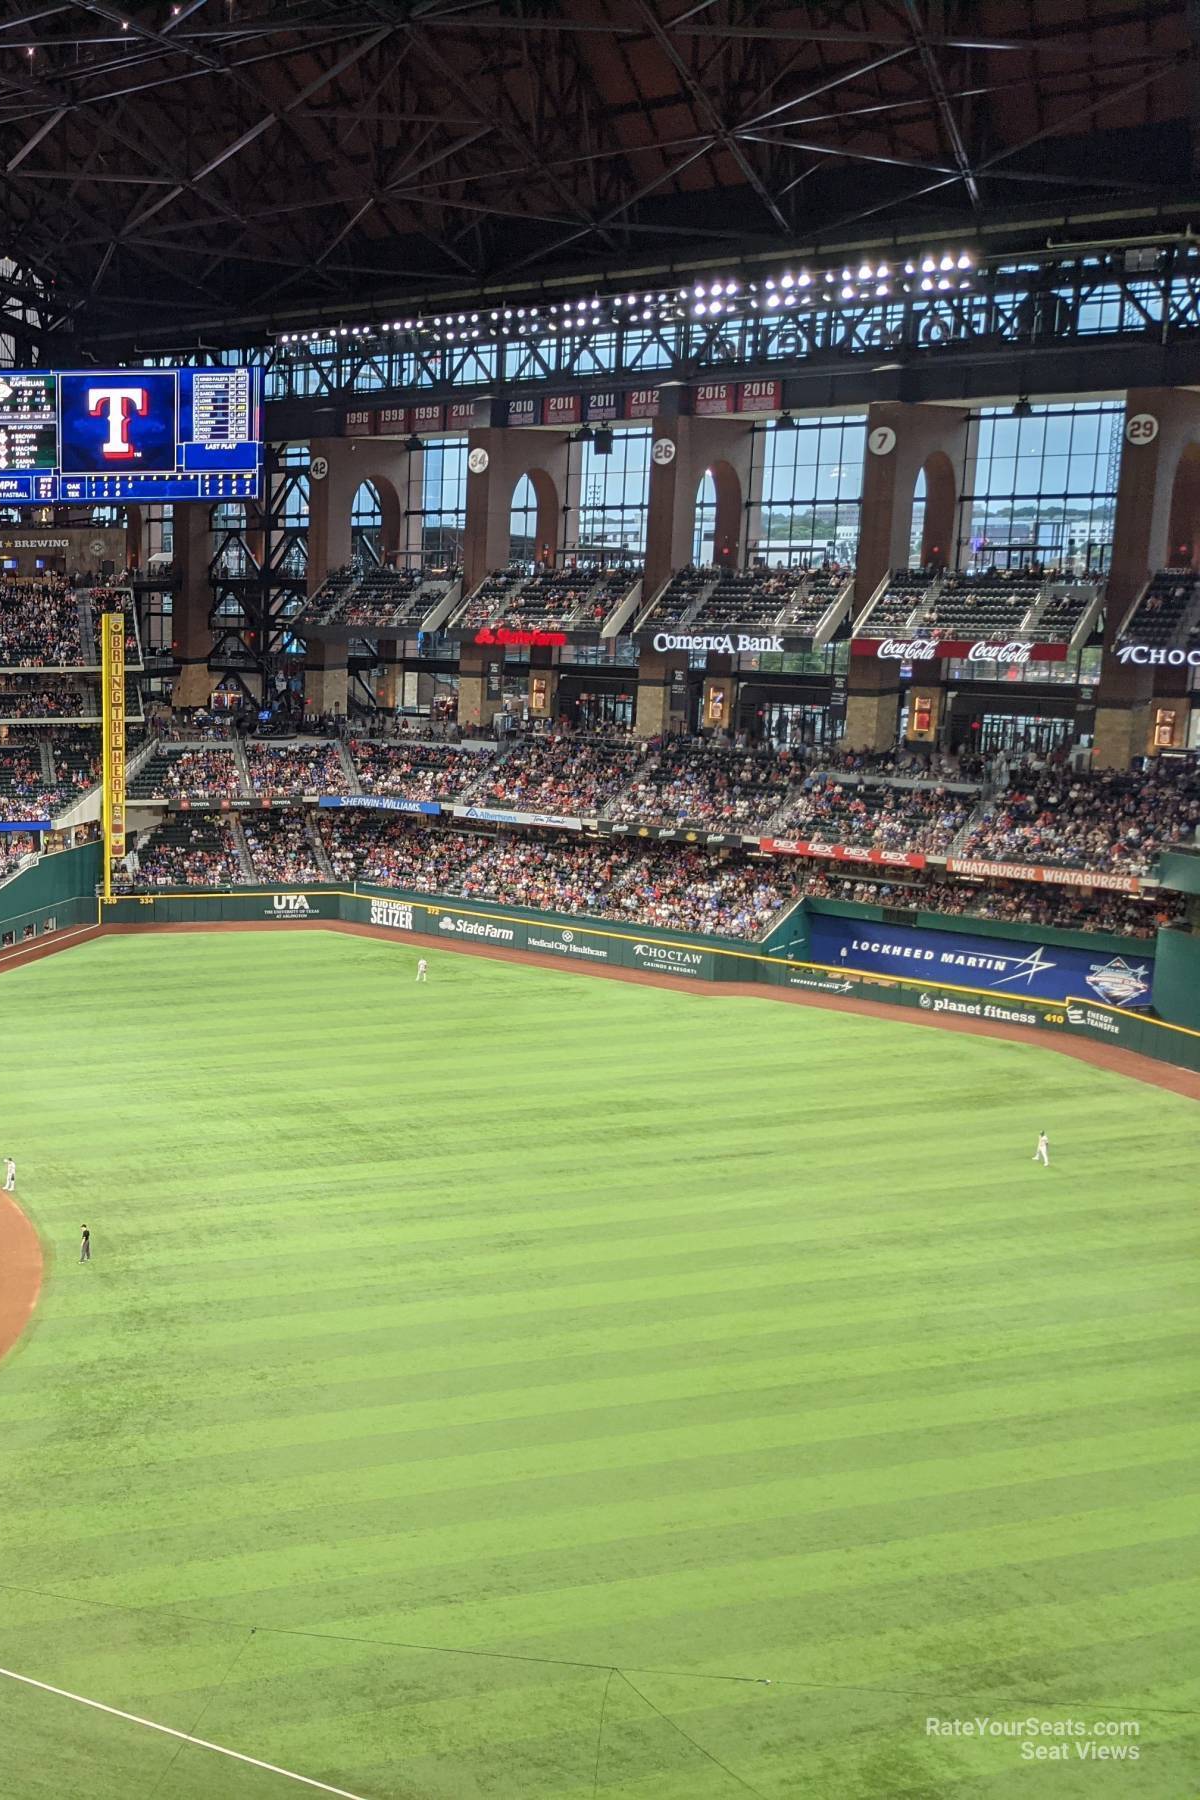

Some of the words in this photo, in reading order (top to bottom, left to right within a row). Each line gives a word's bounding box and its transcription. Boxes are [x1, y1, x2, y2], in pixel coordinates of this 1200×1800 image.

[698, 386, 726, 399] 2015
[744, 382, 774, 396] 2016
[550, 397, 574, 410] 2011
[590, 394, 615, 407] 2011
[631, 390, 659, 404] 2012
[415, 406, 440, 419] 1999
[509, 400, 534, 413] 2010
[346, 412, 369, 424] 1996
[381, 409, 405, 421] 1998
[88, 387, 147, 459] T
[1130, 420, 1155, 438] 29
[877, 433, 890, 450] 7
[654, 444, 673, 460] 26
[470, 453, 487, 468] 34
[312, 461, 326, 475] 42
[67, 490, 80, 498] TEX
[14, 538, 69, 549] BREWING
[737, 635, 785, 652] Bank
[112, 635, 121, 703] BRING
[112, 707, 121, 747] THE
[113, 751, 122, 804] HEAT
[480, 810, 517, 823] Albertsons
[772, 840, 799, 850] DEX
[808, 843, 835, 854] DEX
[843, 847, 871, 858] DEX
[880, 851, 908, 862] DEX
[951, 859, 1035, 880] WHATABURGER
[1042, 870, 1132, 891] WHATABURGER
[273, 894, 310, 910] UTA
[371, 898, 389, 908] BUD
[389, 901, 412, 912] LIGHT
[370, 907, 412, 930] SELTZER
[527, 937, 553, 950] Medical
[554, 941, 568, 953] City
[569, 943, 608, 958] Healthcare
[639, 944, 703, 965] CHOCTAW
[852, 940, 934, 960] LOCKHEED
[940, 949, 1007, 971] MARTIN
[643, 961, 667, 970] CASINOS
[933, 998, 982, 1017] planet
[983, 1004, 1036, 1025] fitness
[1043, 1012, 1064, 1024] 410
[1087, 1009, 1114, 1024] ENERGY
[1087, 1017, 1120, 1034] TRANSFER
